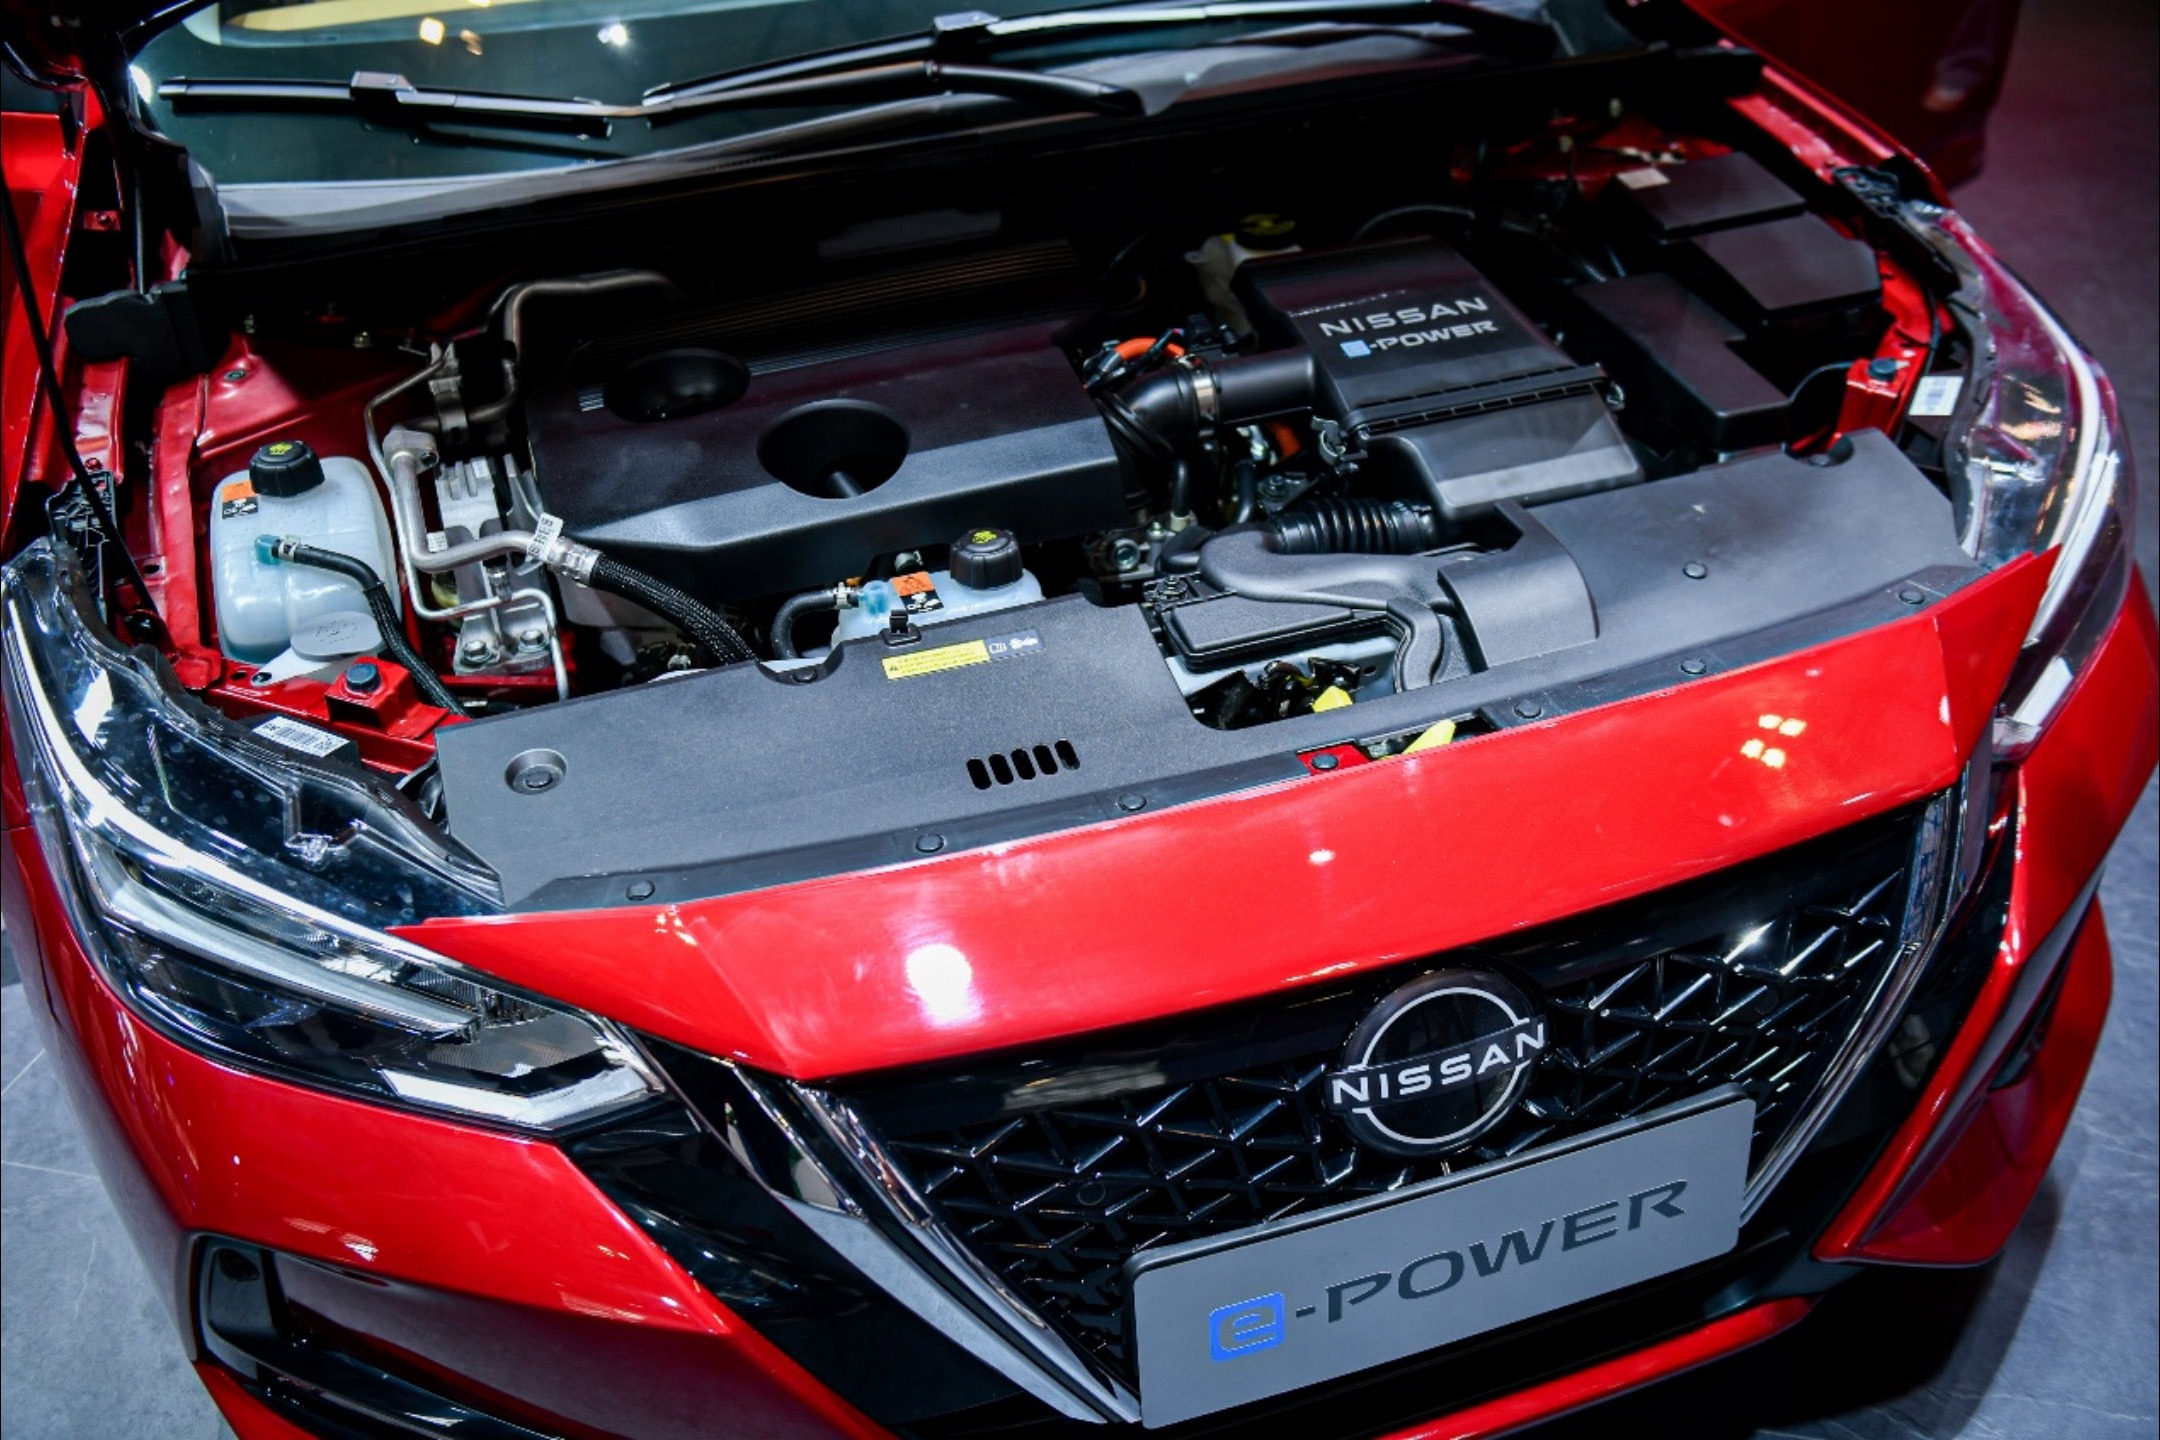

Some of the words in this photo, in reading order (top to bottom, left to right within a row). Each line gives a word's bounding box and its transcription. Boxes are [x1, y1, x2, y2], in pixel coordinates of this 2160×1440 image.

[1319, 297, 1489, 337] NISSAN
[1340, 320, 1499, 359] -POWER
[1332, 1022, 1545, 1104] NISSAN
[1209, 1179, 1688, 1362] e-POWER
